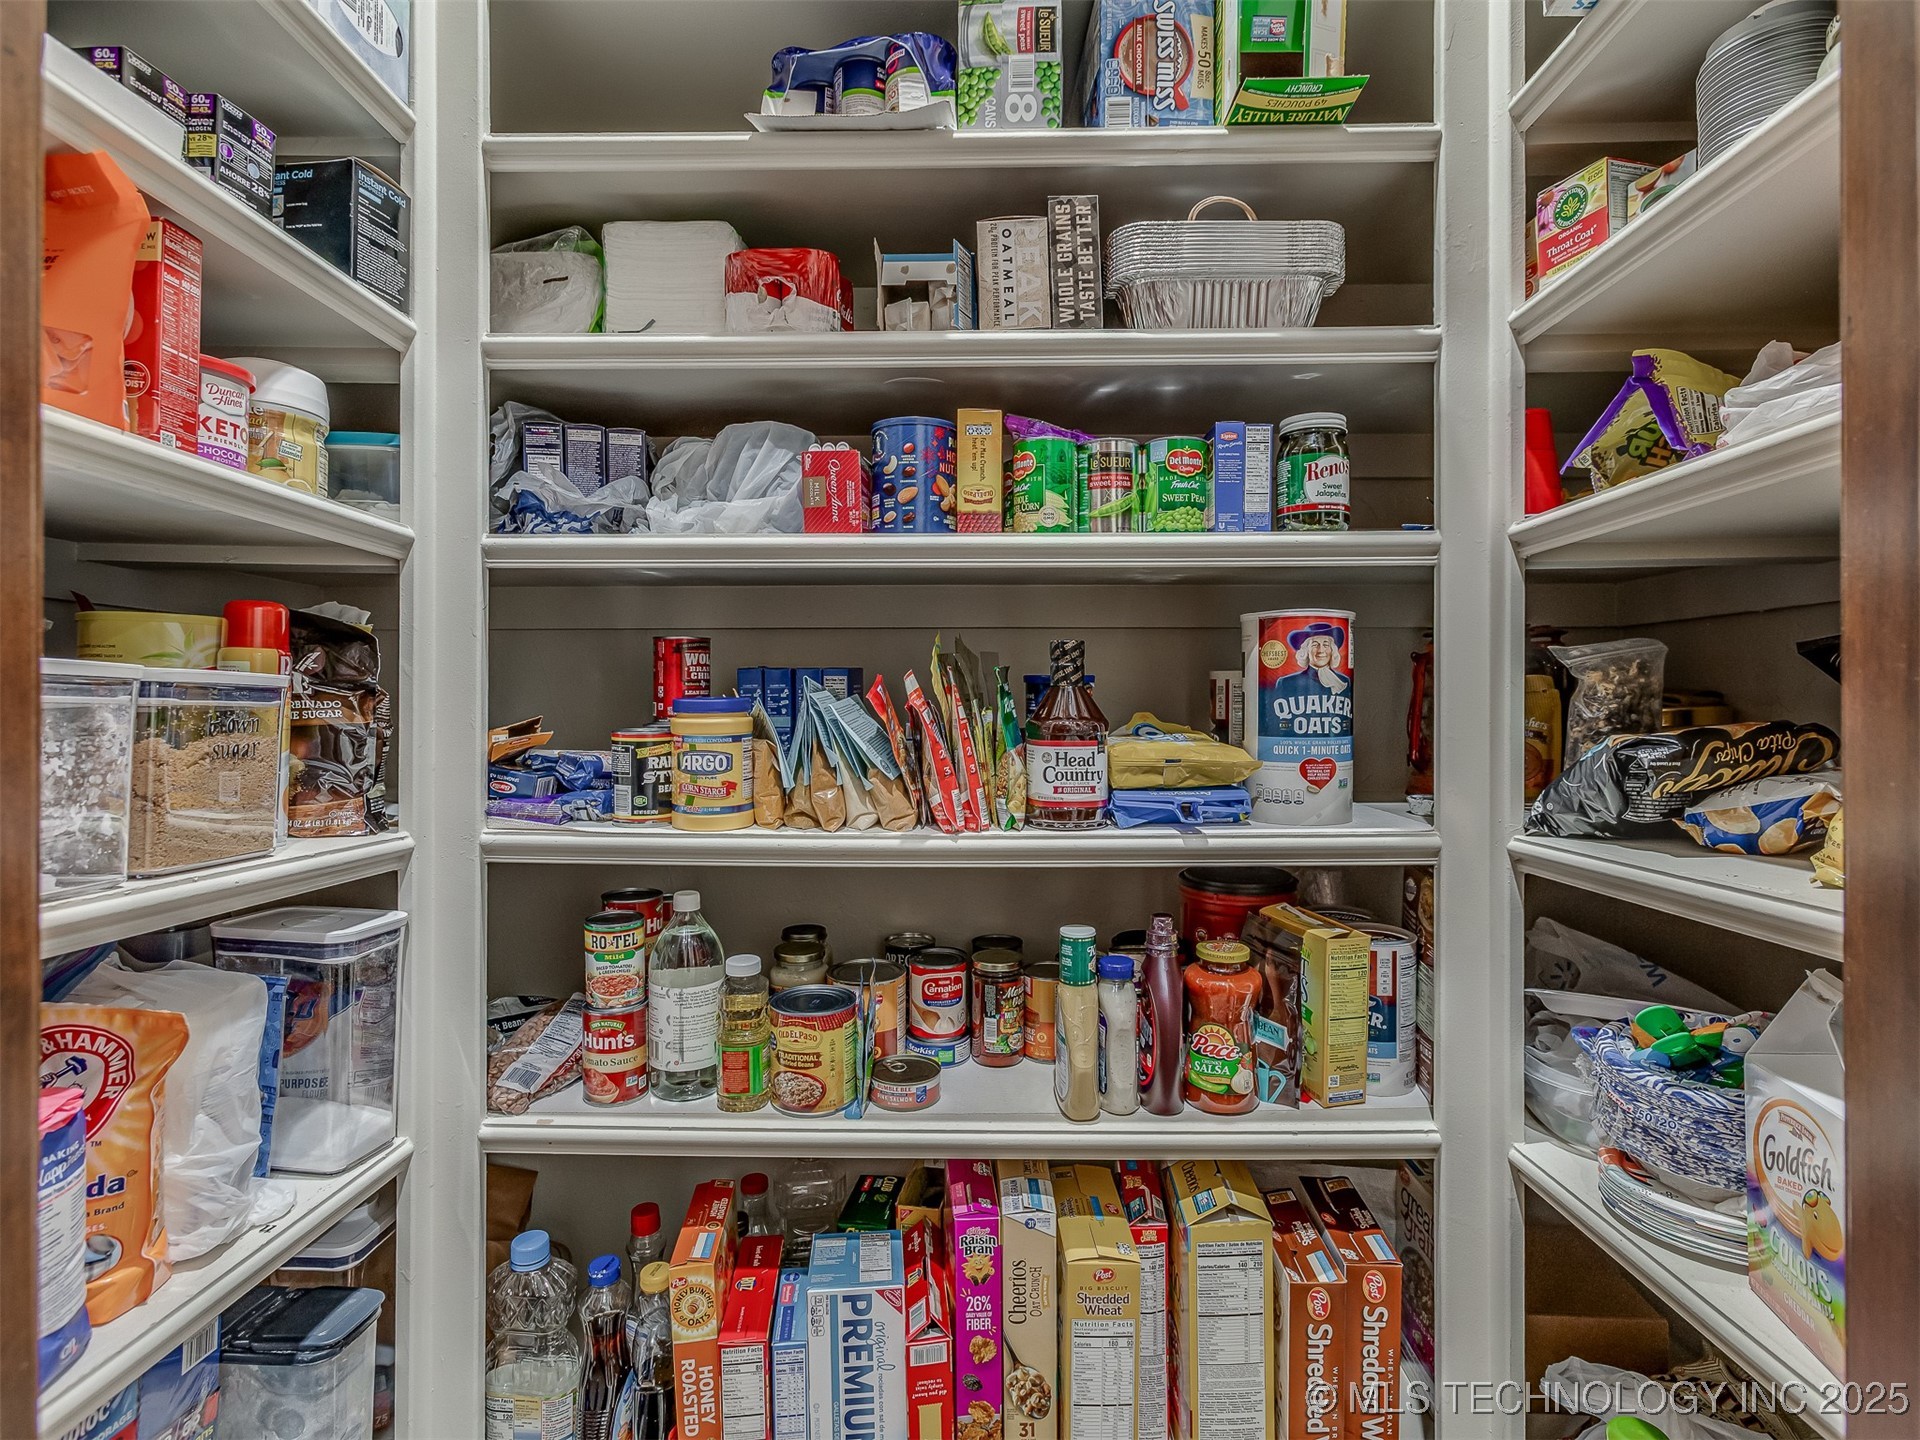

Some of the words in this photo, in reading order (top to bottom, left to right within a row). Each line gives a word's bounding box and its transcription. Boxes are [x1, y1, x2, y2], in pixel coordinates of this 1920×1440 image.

[1018, 9, 1026, 33] sweet
[1154, 0, 1177, 60] SWISS
[1017, 34, 1026, 52] peas
[1038, 19, 1051, 52] SUEUR
[1135, 24, 1143, 43] MILK
[1200, 25, 1208, 50] MAKES
[1135, 44, 1143, 85] CHOCOLATE
[1197, 51, 1211, 67] 50
[1196, 69, 1205, 90] MUGS
[1284, 83, 1323, 93] CRUNCHY
[984, 97, 997, 129] CANS
[1004, 93, 1037, 123] 8
[1265, 99, 1314, 108] POUCHES
[1231, 108, 1288, 124] VALLEY
[1288, 106, 1348, 123] NATURE
[219, 166, 251, 189] AHORRE
[251, 182, 271, 200] 28%
[358, 171, 387, 196] Instant
[388, 190, 406, 209] Cold
[1054, 204, 1074, 263] GRAINS
[1075, 204, 1094, 265] BETTER
[1557, 223, 1584, 241] ORGANIC
[990, 234, 999, 258] PROTEIN
[1546, 237, 1573, 259] Throat
[990, 270, 999, 285] PEAK
[1001, 228, 1016, 321] OATMEAL
[1017, 224, 1044, 325] PEAK
[1058, 267, 1075, 323] WHOLE
[1079, 271, 1096, 321] TASTE
[990, 286, 999, 327] PERFORMANCE
[205, 382, 245, 399] Duncan
[212, 395, 243, 409] Hines
[199, 414, 249, 445] KETO
[197, 443, 247, 466] CHOCOLATE
[212, 455, 240, 468] FROSTING
[1100, 456, 1131, 468] SUEUR
[1169, 456, 1181, 465] Del
[1181, 456, 1203, 466] Monte
[1089, 480, 1112, 488] sweet
[1114, 480, 1131, 488] peas
[1021, 502, 1041, 511] CORN
[1162, 494, 1188, 504] SWEET
[1273, 694, 1353, 719] QUAKER
[206, 714, 260, 735] brown
[1293, 716, 1341, 734] OATS
[1273, 745, 1299, 755] QUICK
[1302, 745, 1339, 755] 1-MINUTE
[1340, 744, 1351, 755] OATS
[1757, 731, 1799, 751] Pita
[211, 739, 261, 764] sugar
[1054, 751, 1096, 767] Head
[1714, 742, 1755, 765] Chips
[681, 754, 730, 771] ARGO
[1042, 765, 1104, 784] Country
[681, 783, 699, 793] CORN
[699, 785, 727, 795] STARCH
[1354, 952, 1368, 960] Facts
[924, 977, 962, 995] Carnation
[499, 1018, 527, 1031] Beans
[1259, 1020, 1280, 1036] BEAN
[583, 1031, 637, 1050] Hunt's
[908, 1042, 936, 1055] StarKist
[1192, 1032, 1240, 1060] Pace
[41, 1037, 52, 1049] &
[53, 1031, 128, 1100] HAMMER
[609, 1055, 639, 1066] Sauce
[778, 1052, 818, 1062] TRADITIONAL
[1194, 1062, 1231, 1076] SALSA
[280, 1076, 329, 1089] PURPOSE
[42, 1140, 80, 1166] BAKING
[1762, 1134, 1835, 1192] Goldfish
[86, 1174, 126, 1199] da
[1181, 1160, 1201, 1194] Cheerios
[1776, 1175, 1803, 1192] BAKED
[93, 1201, 125, 1217] Brand
[717, 1197, 729, 1220] ROASTED
[959, 1234, 998, 1247] Raisin
[963, 1243, 995, 1257] Bran
[1770, 1227, 1833, 1303] COLORS
[671, 1277, 688, 1288] Post
[1030, 1266, 1043, 1299] CRUNCH
[1095, 1269, 1113, 1281] Post
[1007, 1259, 1028, 1325] Cheerios
[1366, 1273, 1383, 1299] Post
[689, 1286, 714, 1309] BUNCHES
[966, 1296, 992, 1312] 26%
[1076, 1292, 1130, 1305] Shredded
[1310, 1288, 1328, 1317] Post
[1030, 1300, 1042, 1317] OAT
[1084, 1304, 1123, 1316] Wheat
[687, 1311, 711, 1328] OATS
[966, 1317, 992, 1331] FIBER
[873, 1321, 896, 1371] original
[1387, 1348, 1395, 1385] WHEAT
[878, 1373, 886, 1400] rociadas
[1306, 1322, 1334, 1434] Shredded
[680, 1358, 699, 1438] ROASTED
[698, 1365, 717, 1425] HONEY
[878, 1401, 886, 1413] con
[1018, 1422, 1036, 1437] 31
